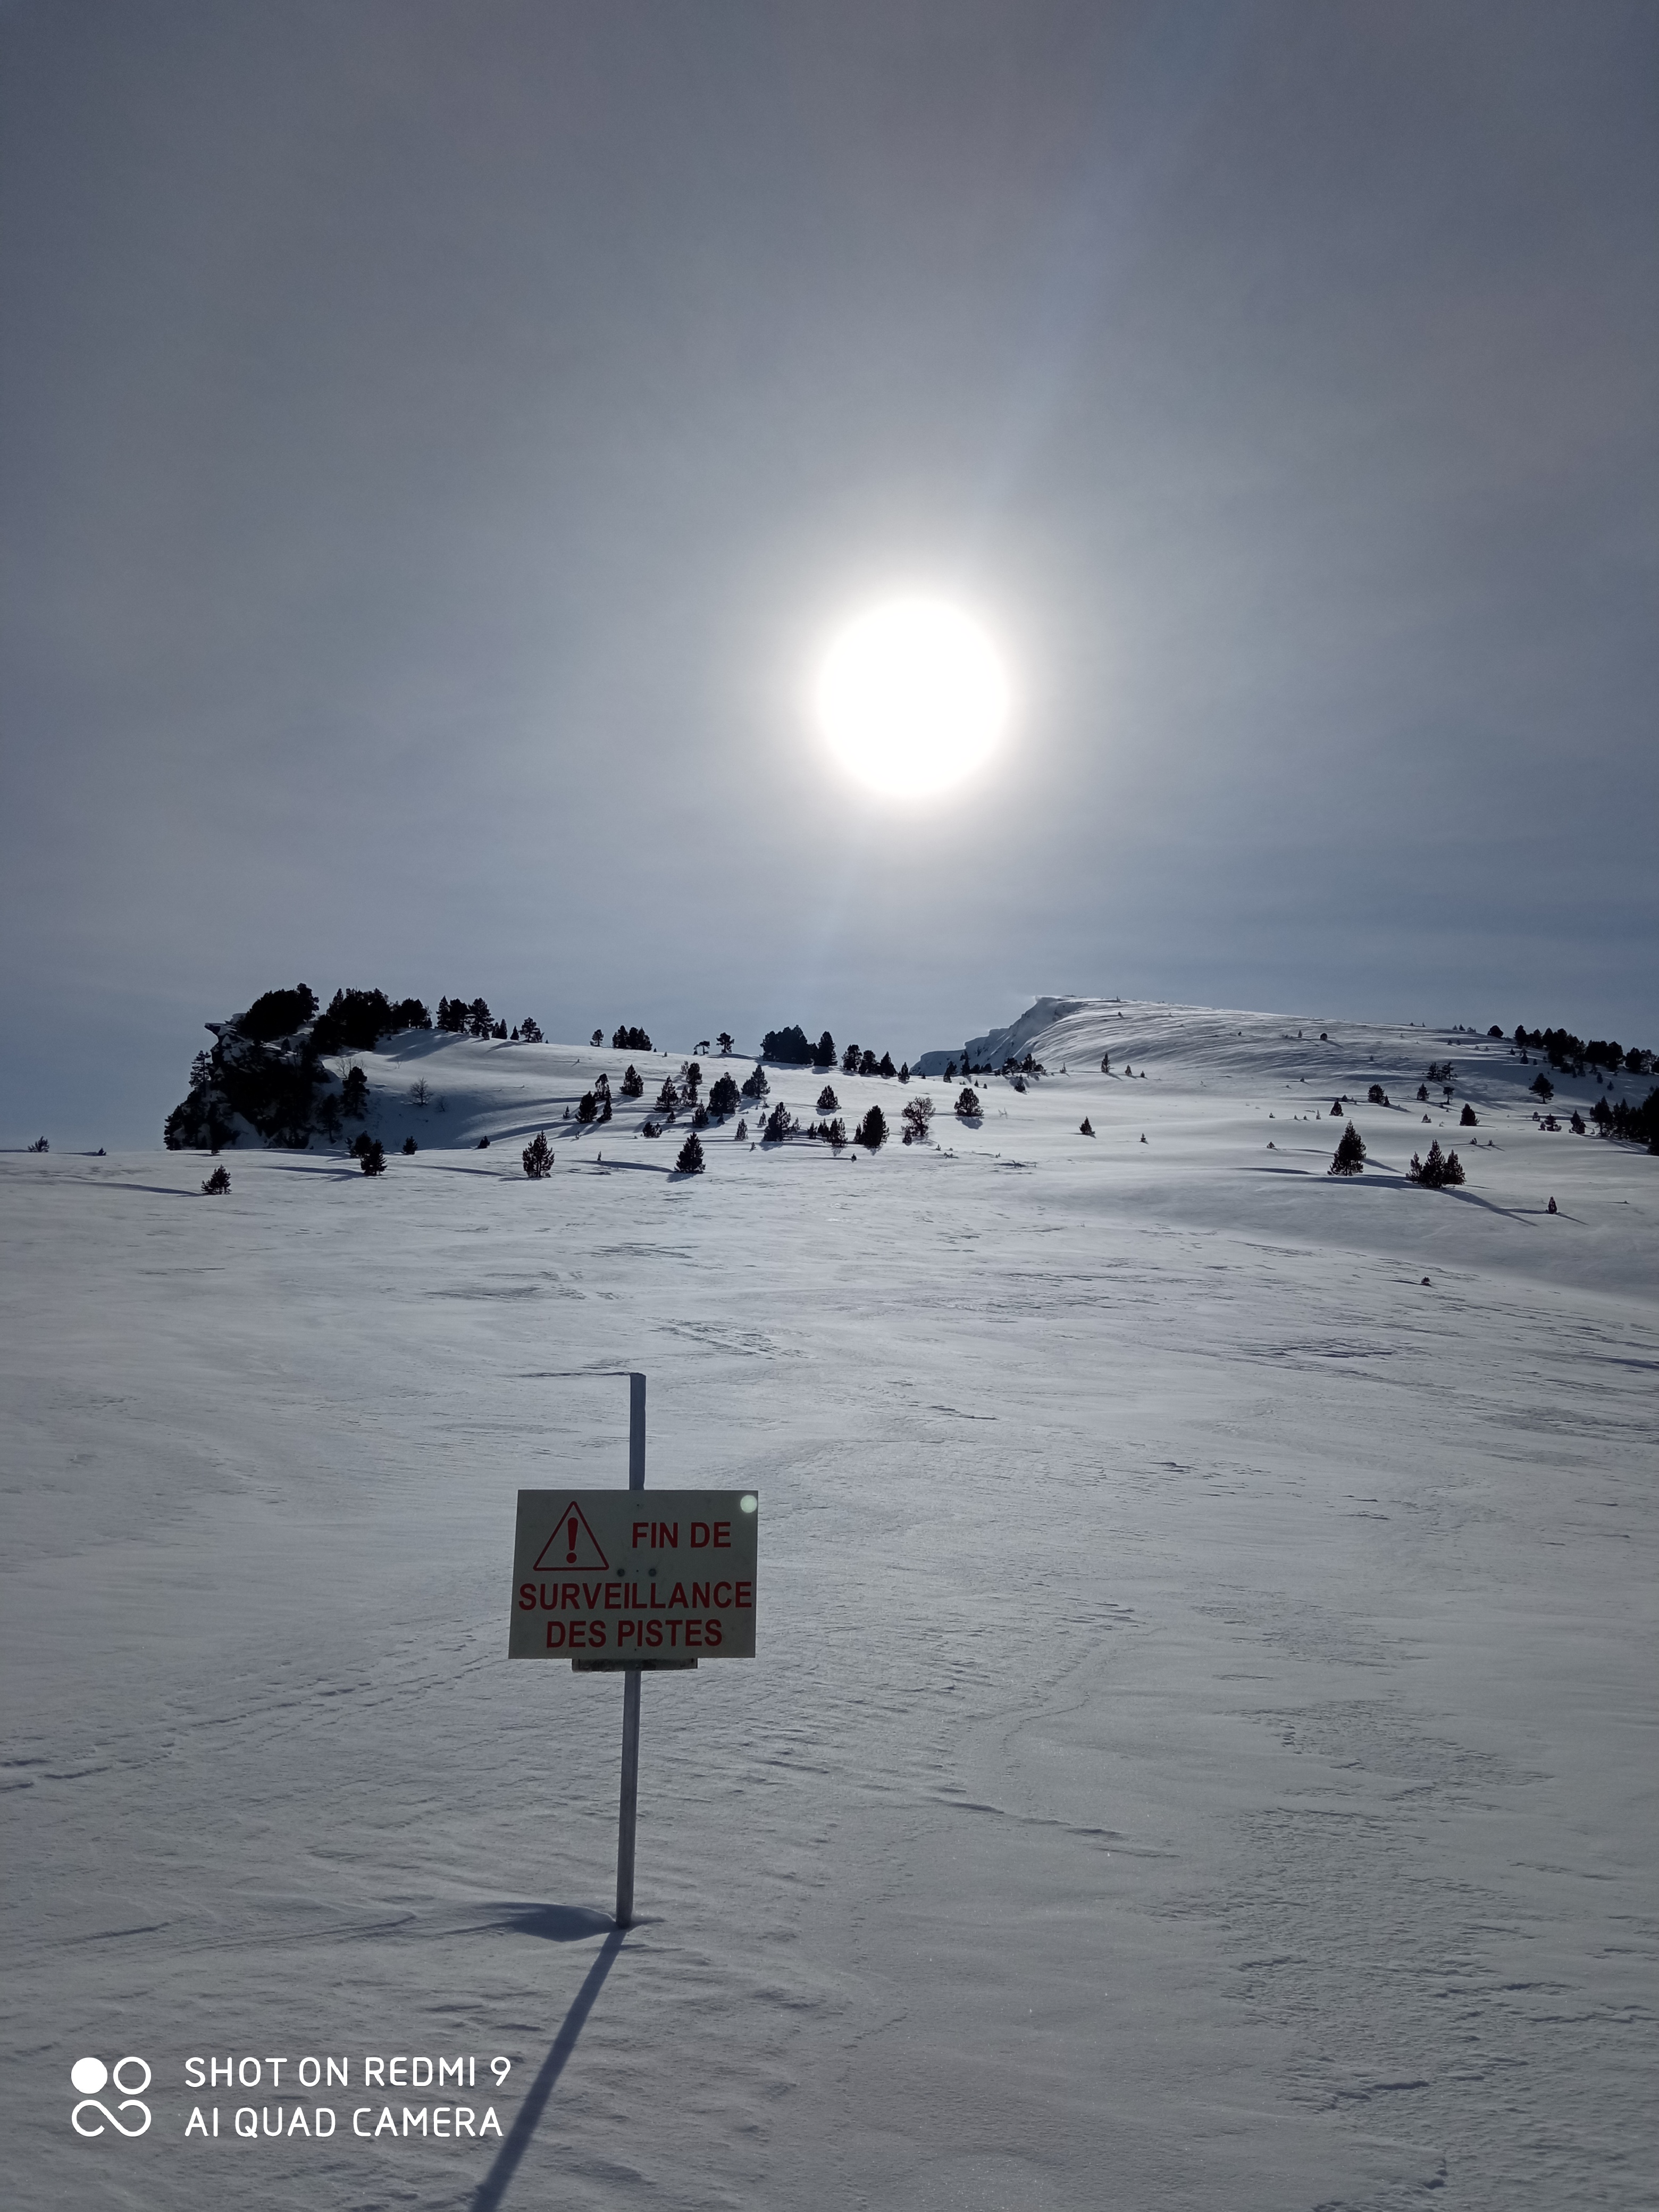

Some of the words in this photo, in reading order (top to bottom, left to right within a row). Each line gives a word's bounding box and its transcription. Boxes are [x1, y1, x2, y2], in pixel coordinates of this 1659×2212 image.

[632, 1522, 678, 1548] FIN
[690, 1522, 731, 1548] DE
[518, 1582, 752, 1610] SURVEILLANCE
[546, 1621, 607, 1648] DES
[617, 1620, 723, 1647] PISTES
